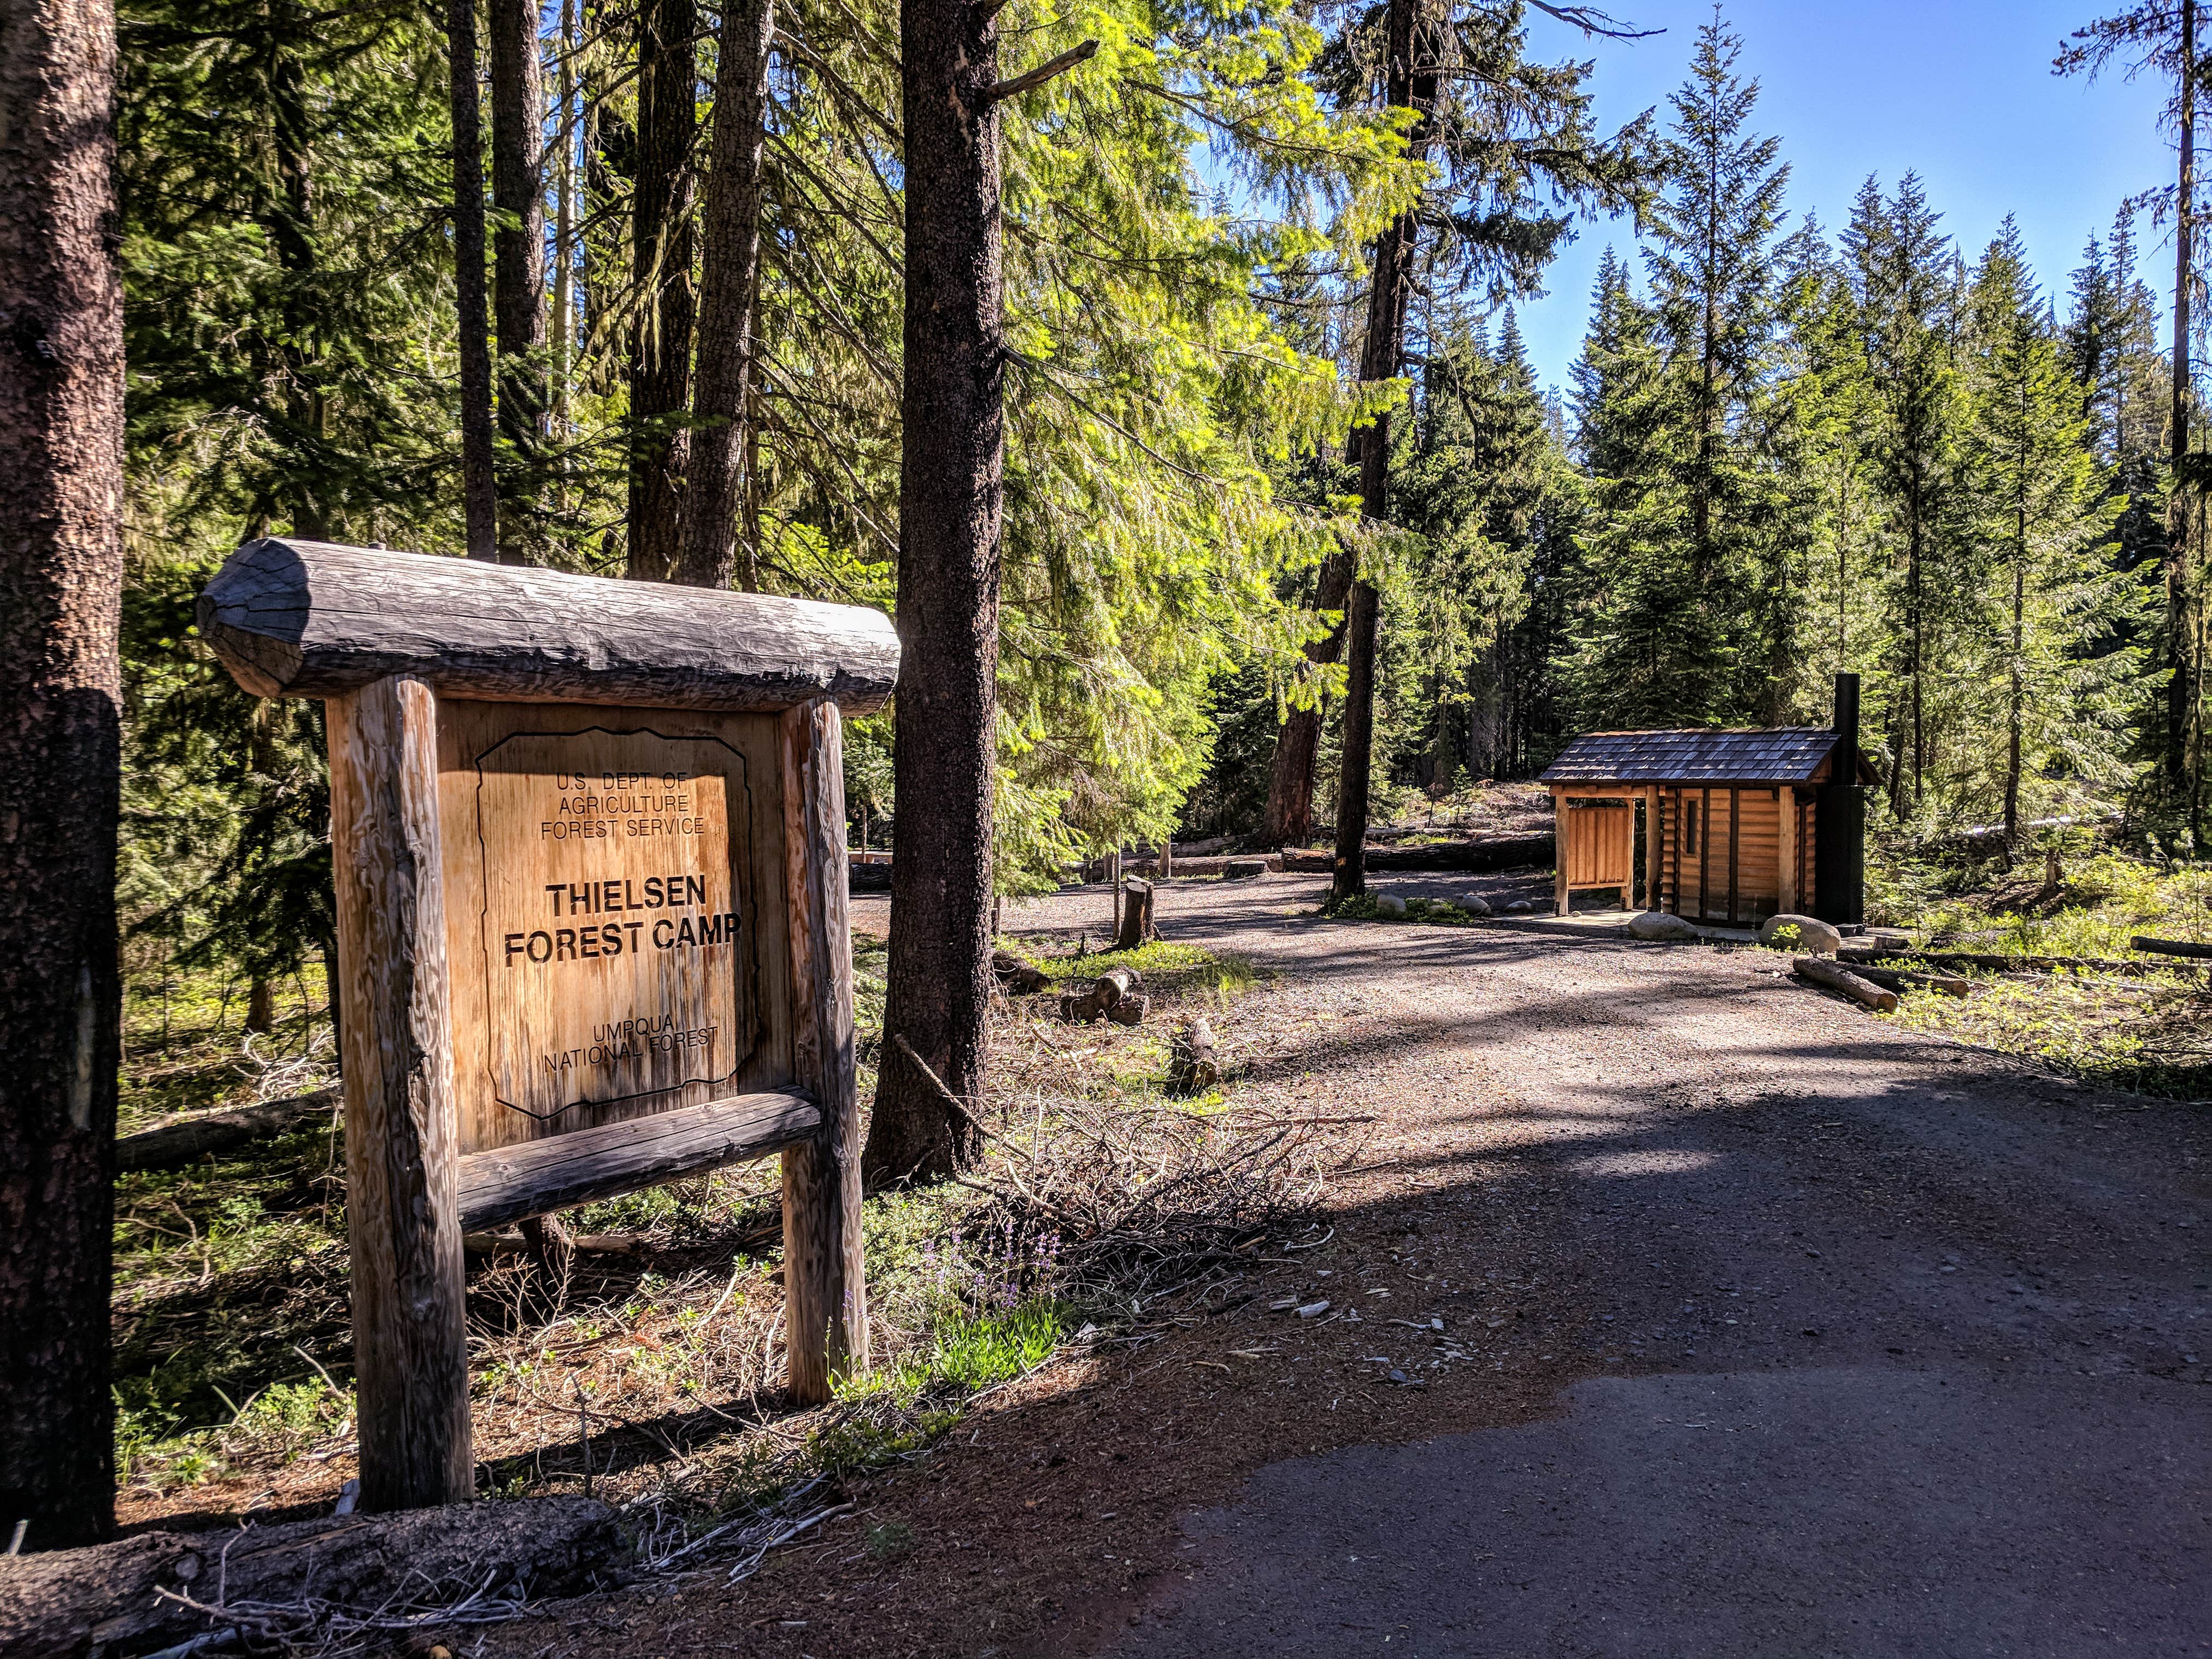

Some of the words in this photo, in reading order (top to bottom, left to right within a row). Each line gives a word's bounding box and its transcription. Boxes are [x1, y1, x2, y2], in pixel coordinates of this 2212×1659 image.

[603, 772, 652, 790] DEPT.
[663, 772, 687, 789] OF
[559, 795, 689, 815] AGRICULTURE
[542, 820, 618, 840] FOREST
[627, 817, 704, 837] SERVICE
[545, 875, 706, 917] THIELSEN
[505, 922, 644, 967] FOREST
[653, 912, 742, 950] CAMP
[593, 1014, 674, 1042] UMPQUA
[544, 1040, 643, 1073] NATIONAL
[649, 1026, 718, 1054] FOREST
